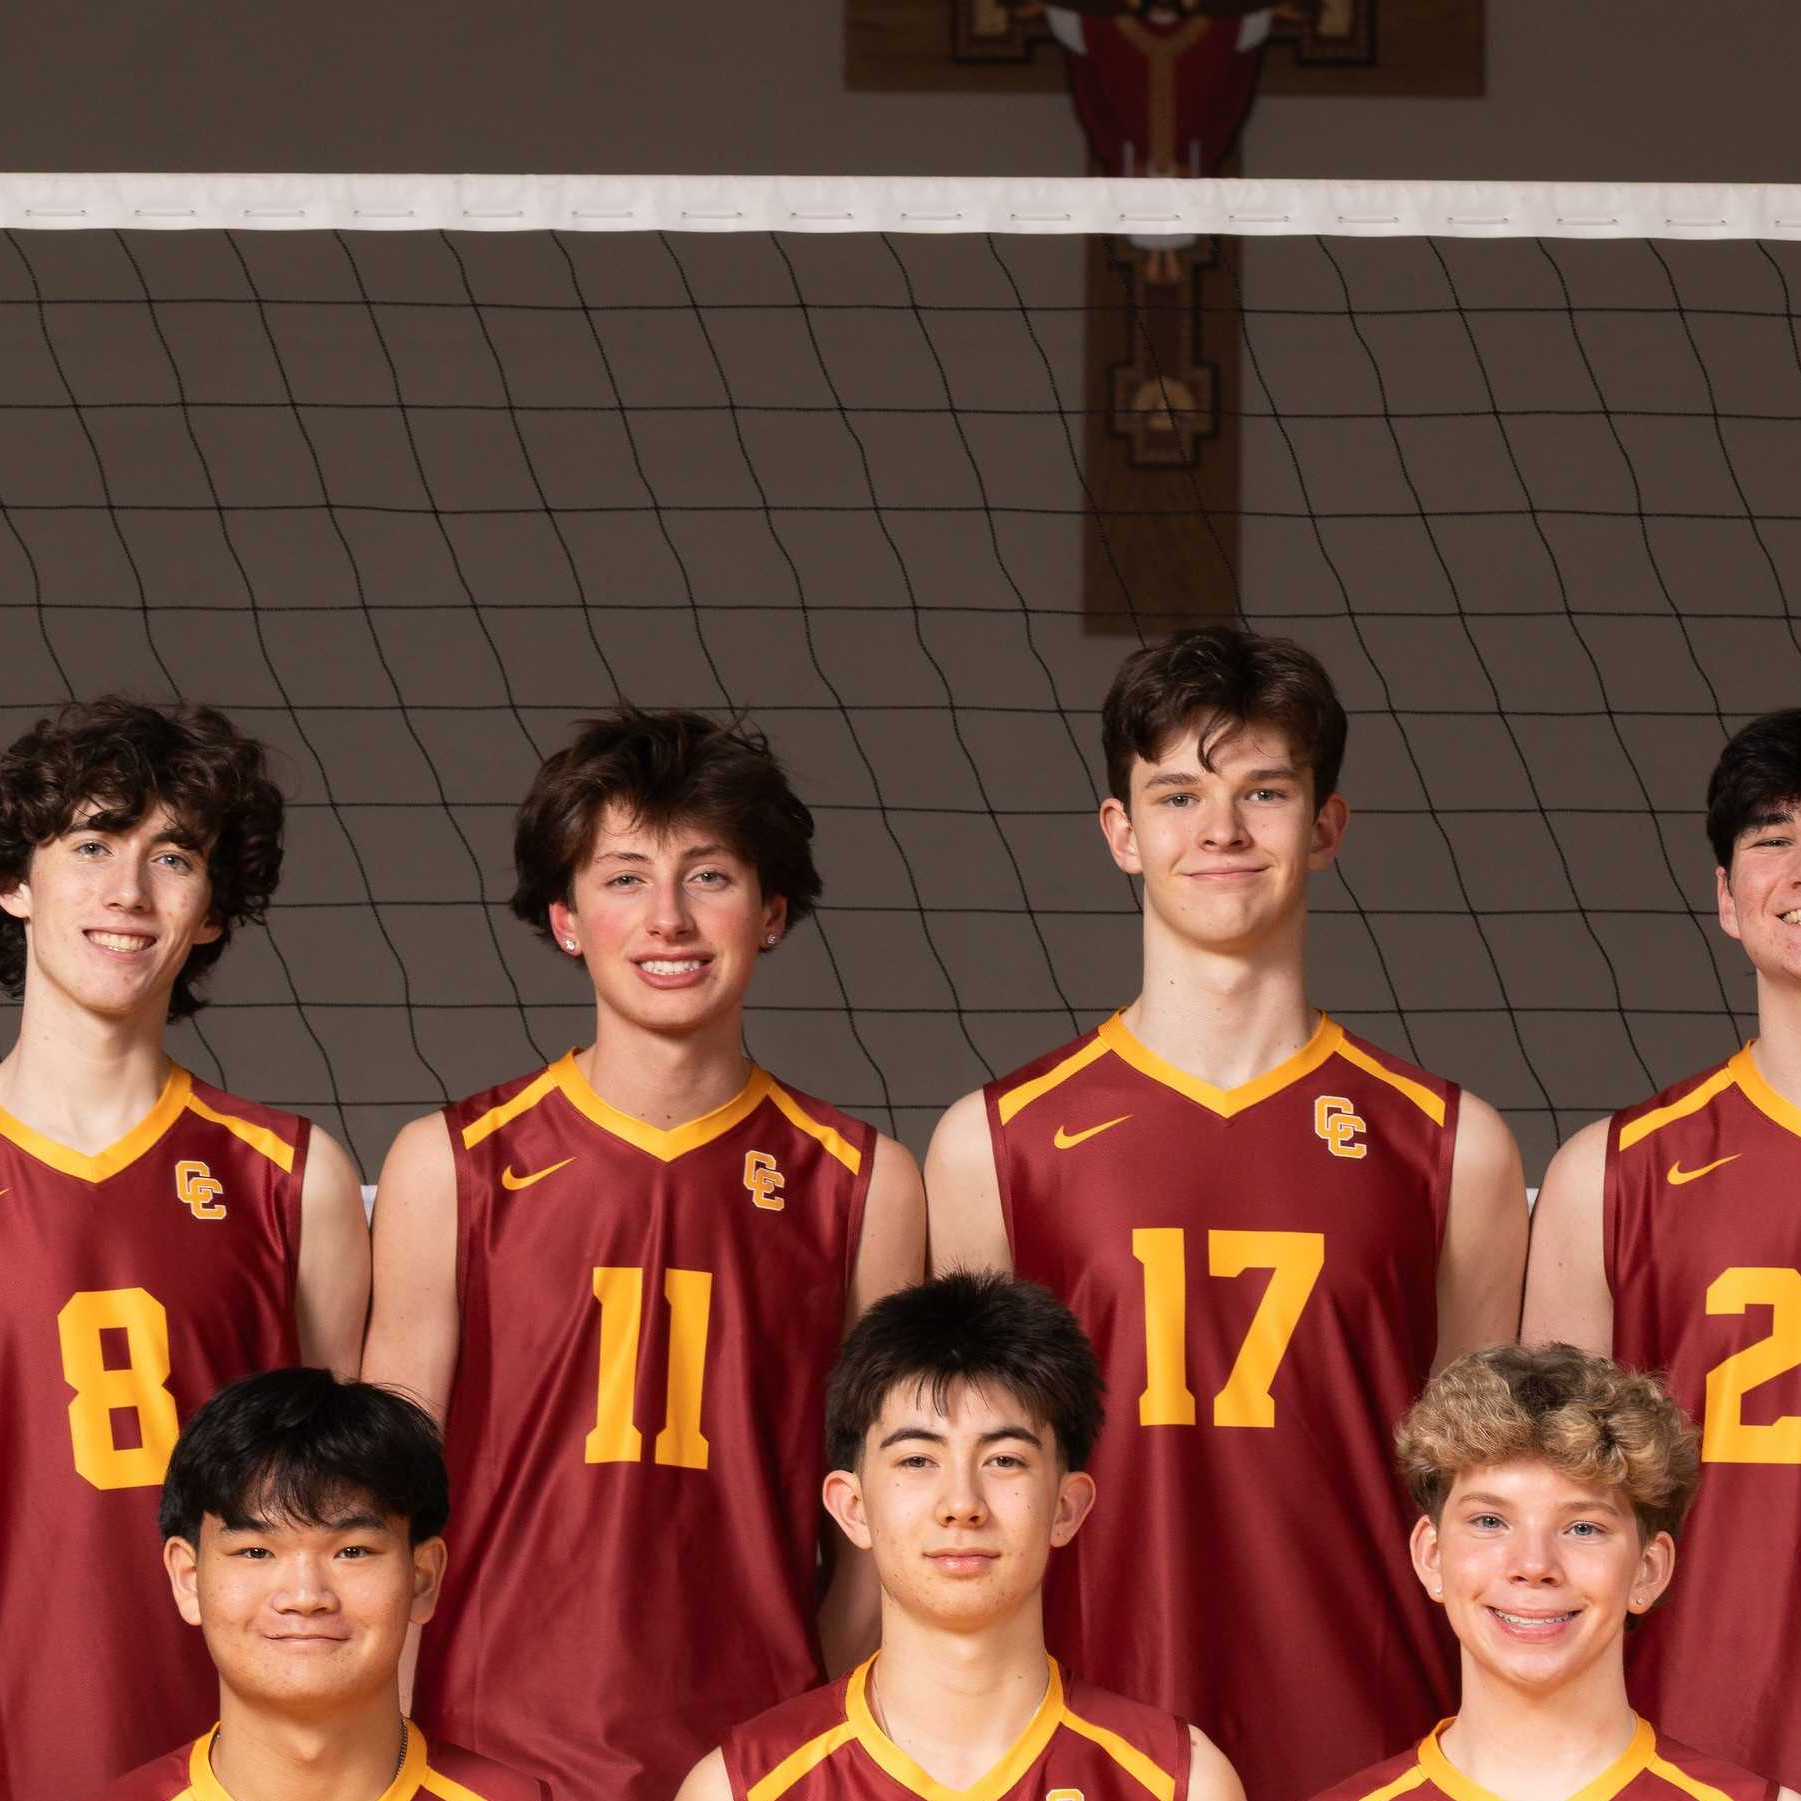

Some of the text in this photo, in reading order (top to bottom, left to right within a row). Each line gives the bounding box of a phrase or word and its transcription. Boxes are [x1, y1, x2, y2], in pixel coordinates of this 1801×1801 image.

[57, 1286, 180, 1491] 8
[583, 1265, 712, 1470] 11
[1130, 1226, 1327, 1429] 17
